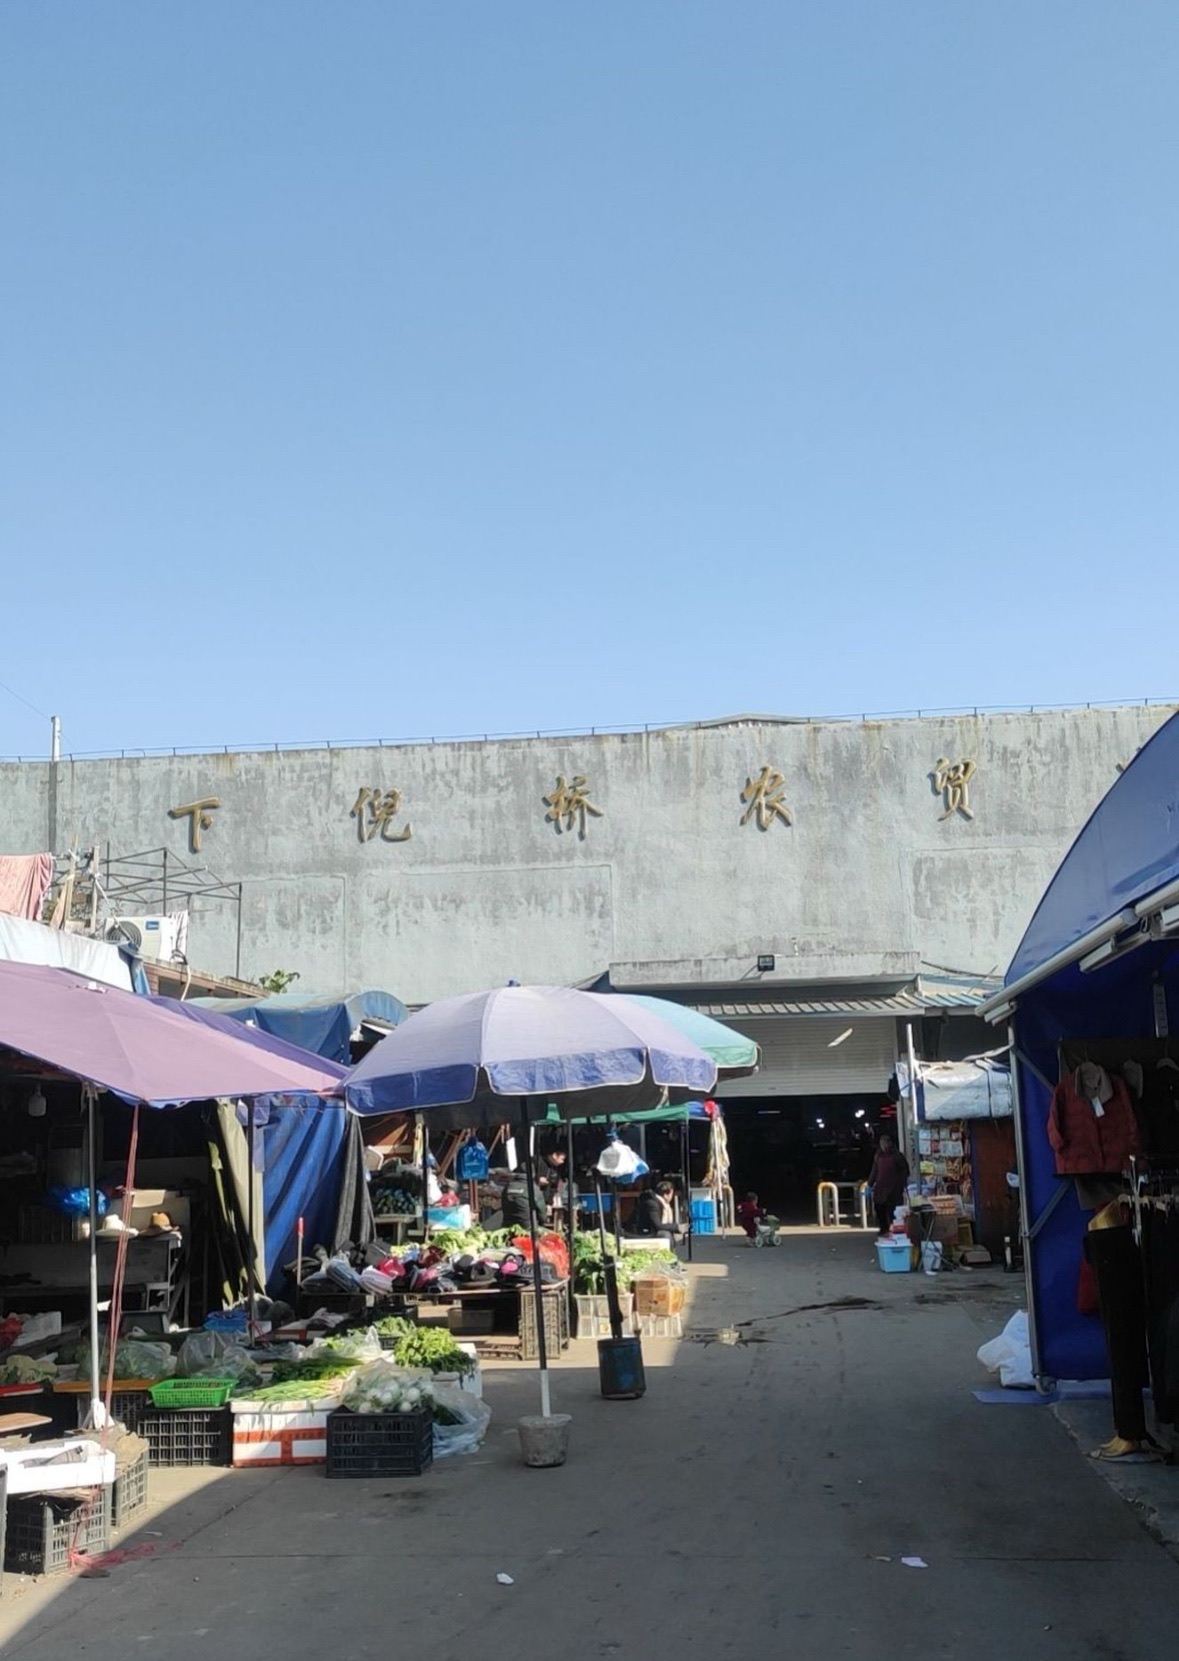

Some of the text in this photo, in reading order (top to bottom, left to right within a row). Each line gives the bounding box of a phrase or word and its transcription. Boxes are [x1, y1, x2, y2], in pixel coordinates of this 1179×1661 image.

[168, 752, 1130, 854] 下倪桥农贸
